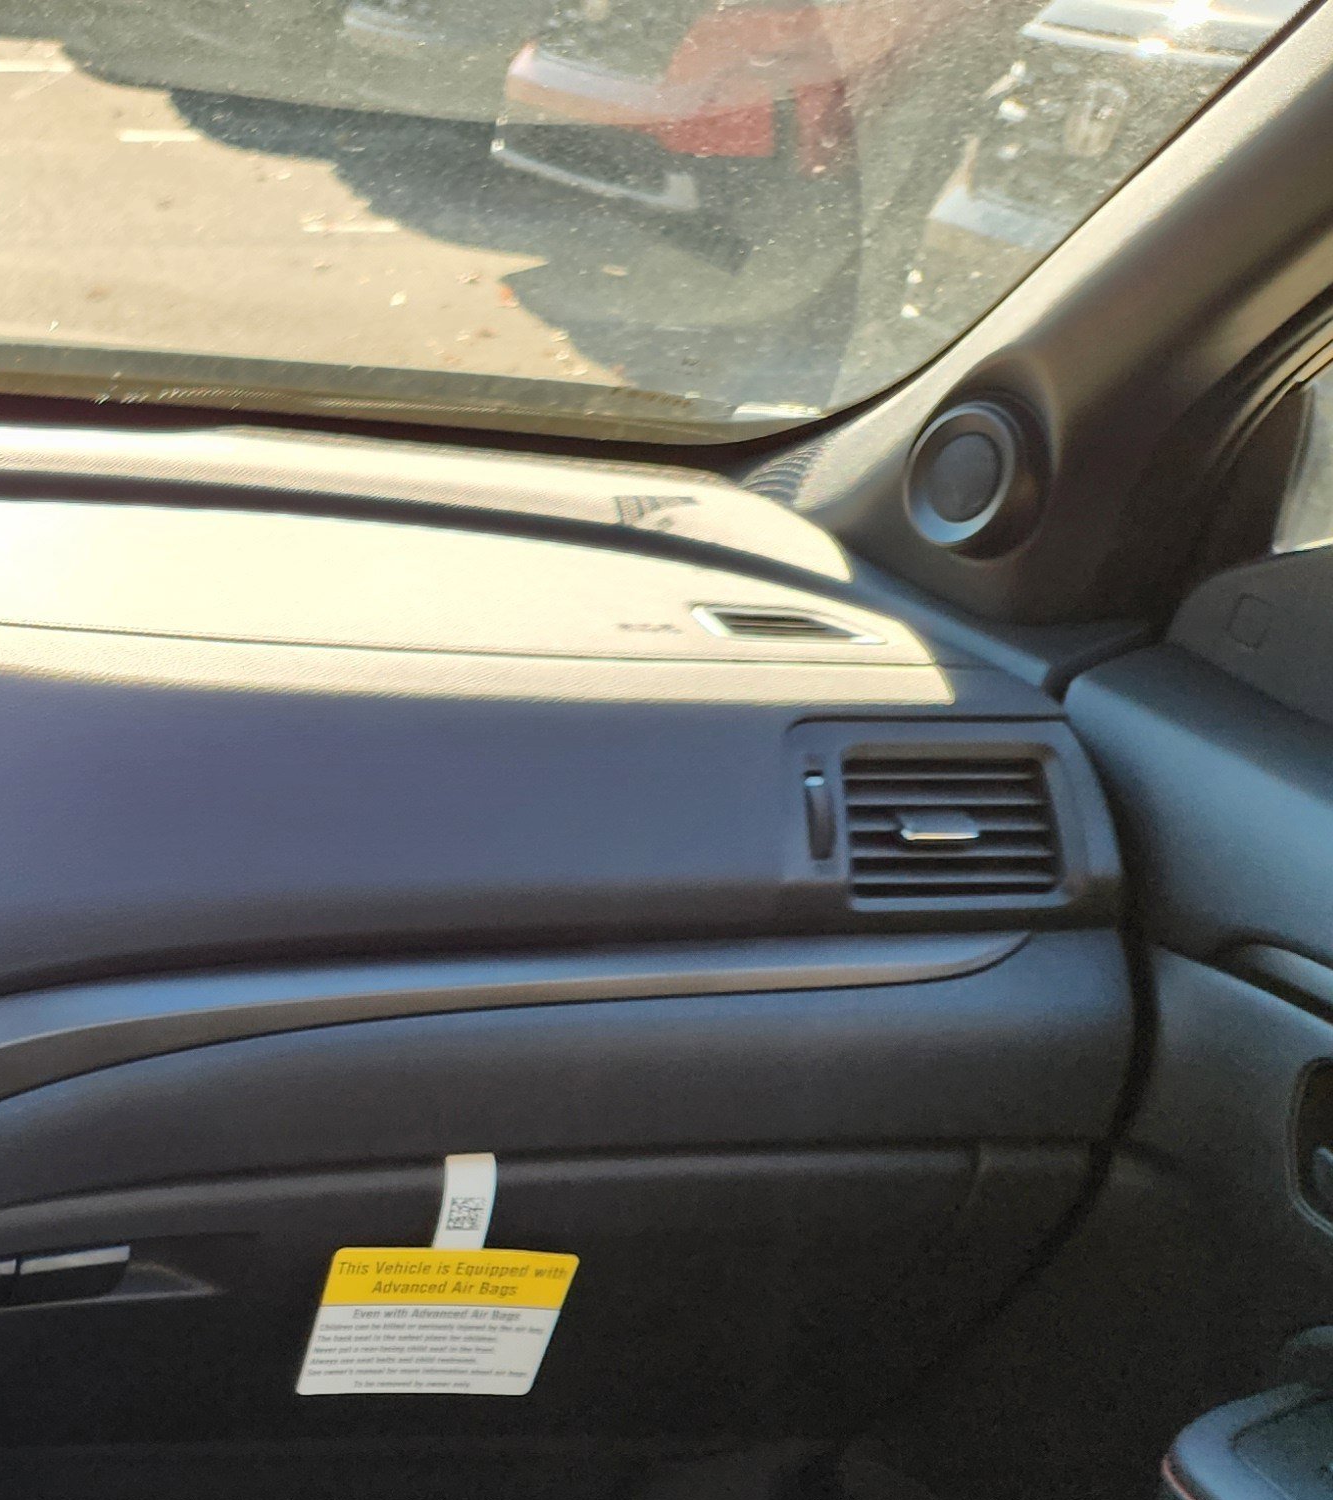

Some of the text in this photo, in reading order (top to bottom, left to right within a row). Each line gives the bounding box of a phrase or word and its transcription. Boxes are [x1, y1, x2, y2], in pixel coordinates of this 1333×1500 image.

[338, 1261, 569, 1280] This Vehicle is Equipped with
[371, 1281, 519, 1298] Advanced Air Bags
[353, 1308, 381, 1319] Even
[383, 1308, 408, 1319] with
[411, 1308, 469, 1320] Advanced
[471, 1310, 488, 1320] Air
